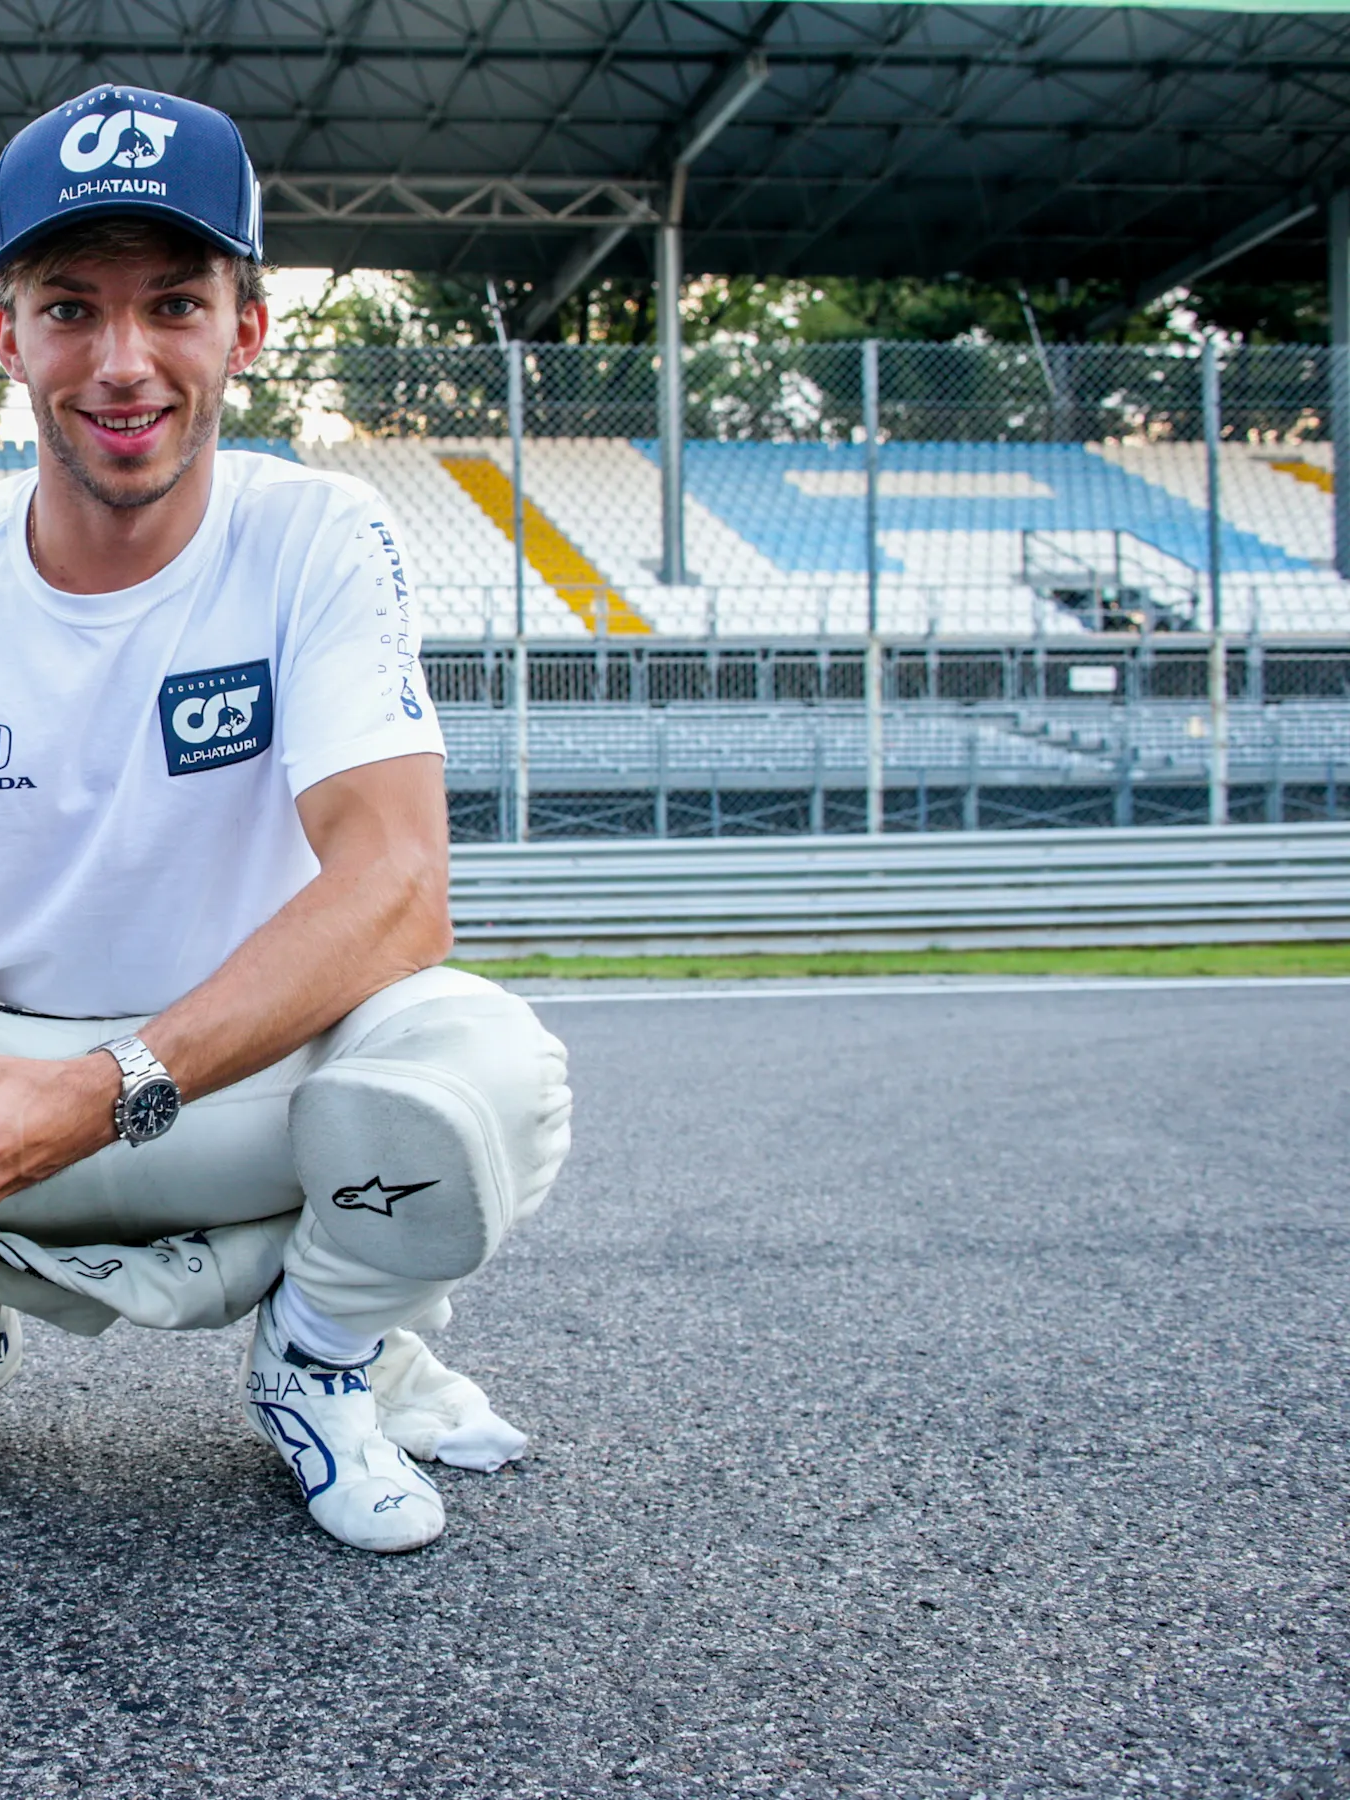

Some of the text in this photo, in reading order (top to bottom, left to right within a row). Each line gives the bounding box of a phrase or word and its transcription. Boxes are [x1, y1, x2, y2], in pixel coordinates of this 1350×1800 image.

[66, 91, 162, 117] SCUDERIA
[59, 179, 167, 203] ALPHATAURI
[355, 531, 396, 722] SCUDER
[168, 674, 247, 694] SCUDERIA
[179, 737, 257, 765] ALPHATAURI
